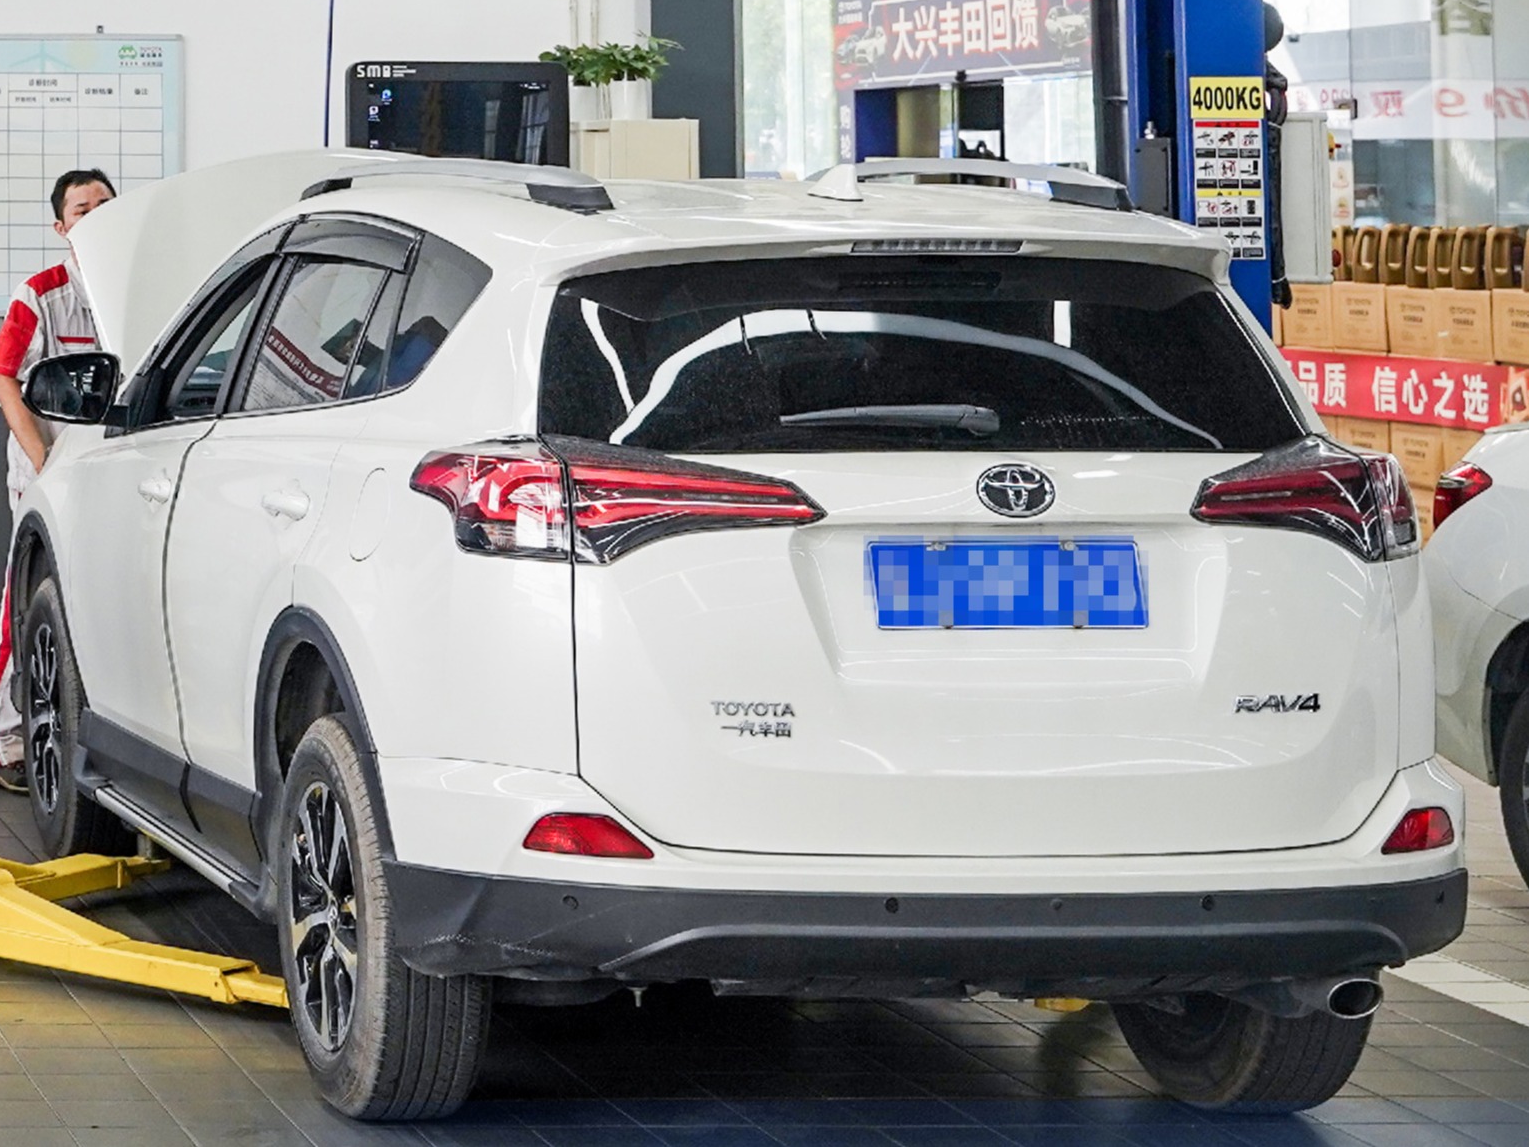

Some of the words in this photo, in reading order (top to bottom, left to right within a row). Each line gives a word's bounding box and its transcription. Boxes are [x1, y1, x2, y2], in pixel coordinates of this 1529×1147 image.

[1192, 86, 1262, 110] 4000KG
[1291, 360, 1347, 408] 品质
[1371, 366, 1490, 423] 信心之选
[710, 700, 795, 717] TOYOTA
[1234, 692, 1321, 714] RAV4
